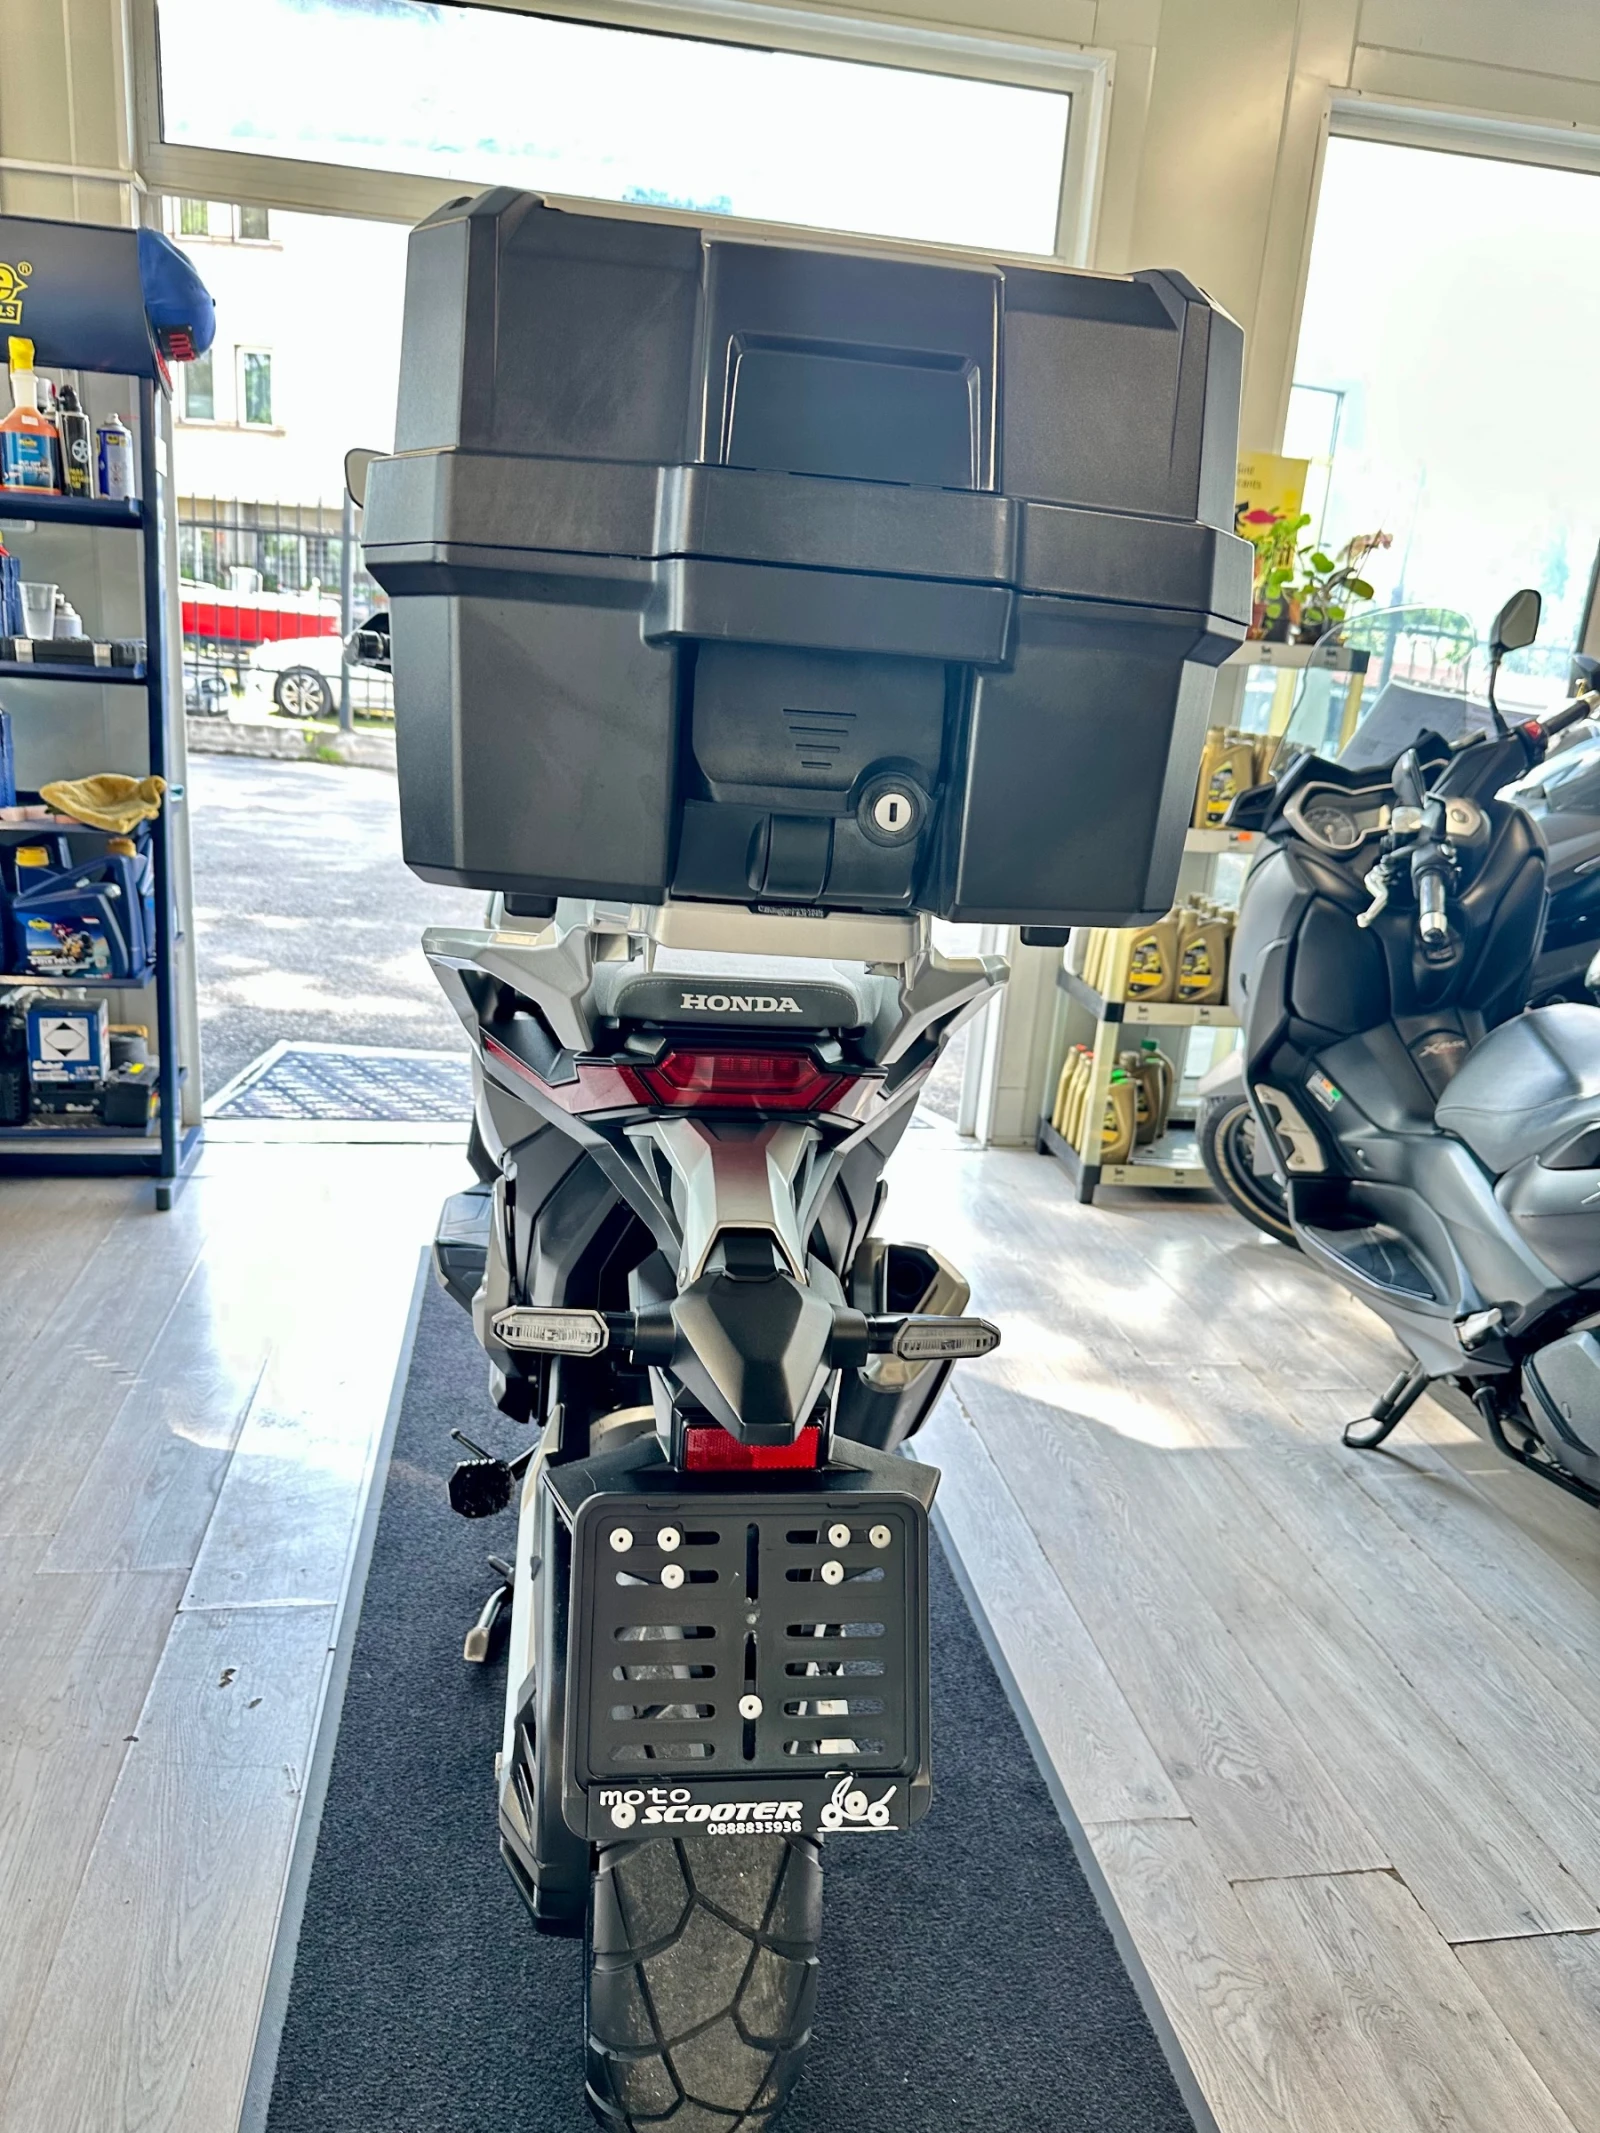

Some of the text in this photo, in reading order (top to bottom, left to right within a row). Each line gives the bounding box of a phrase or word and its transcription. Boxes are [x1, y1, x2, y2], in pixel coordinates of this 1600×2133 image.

[680, 993, 803, 1013] HONDA
[600, 1787, 691, 1806] moto
[641, 1801, 803, 1824] SCOOTER
[707, 1821, 802, 1835] 0888835936
